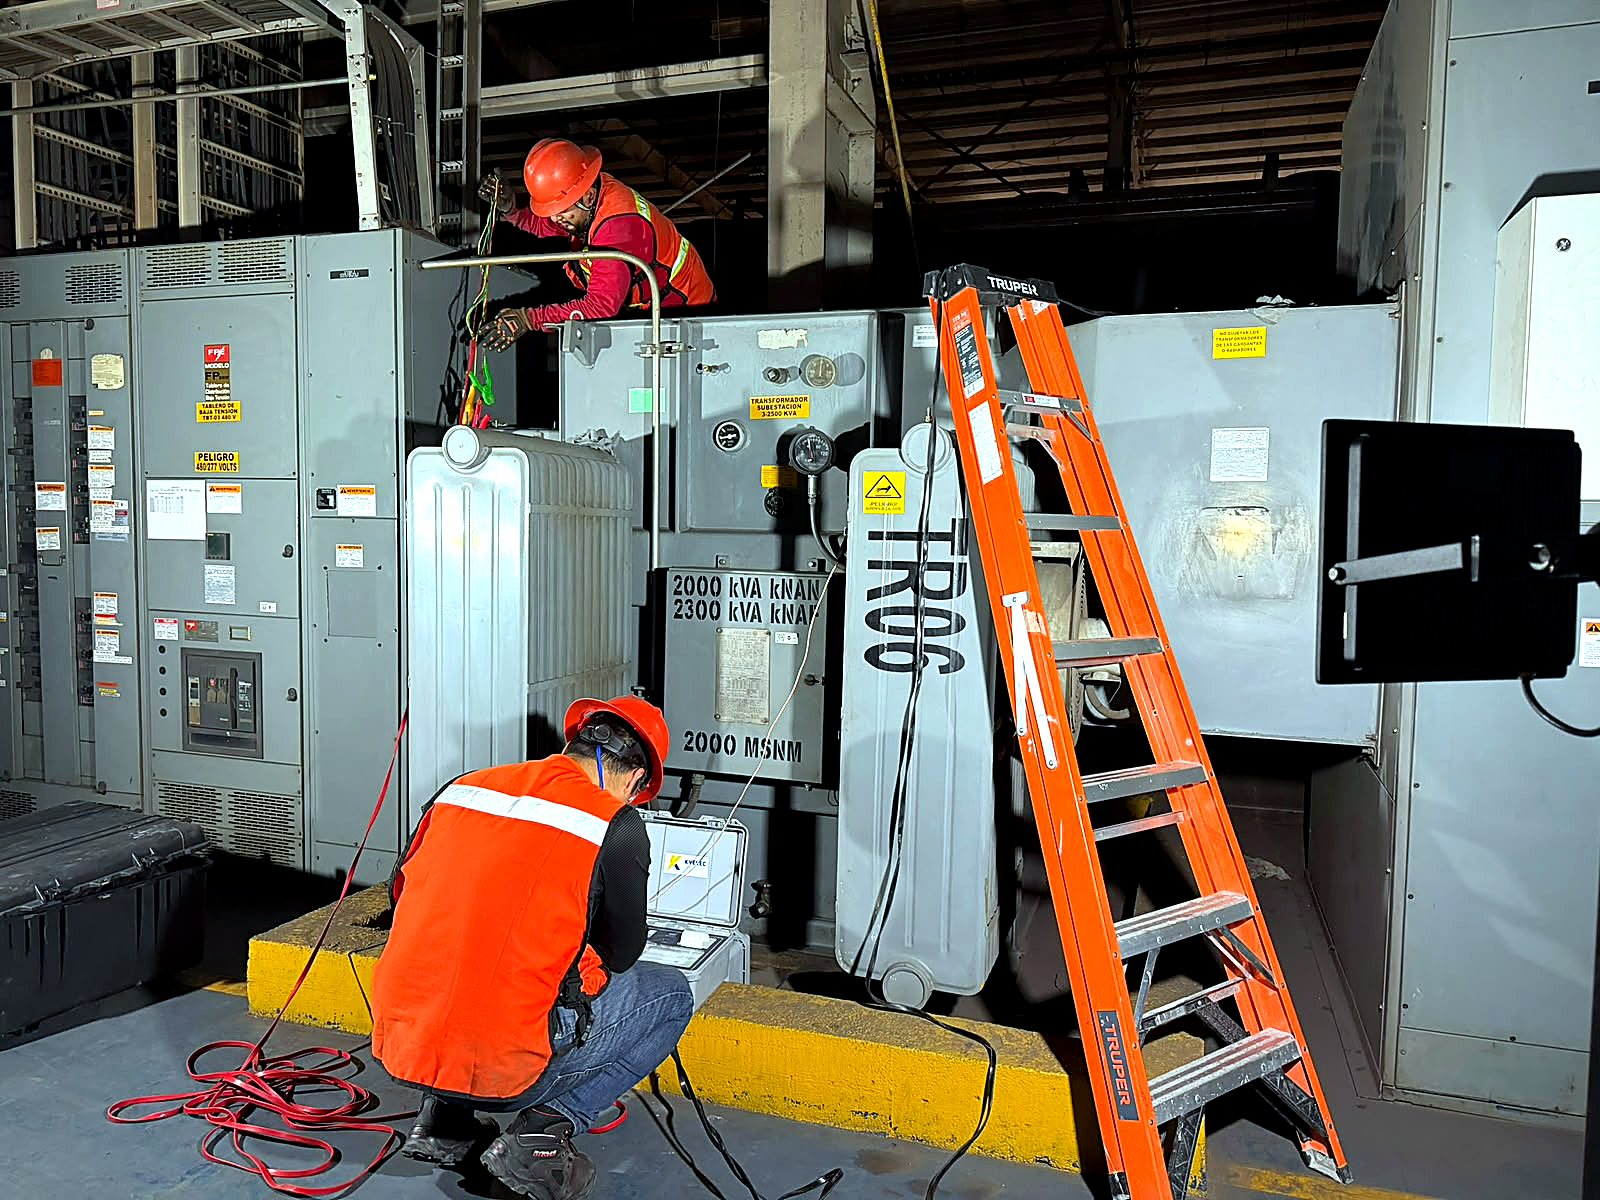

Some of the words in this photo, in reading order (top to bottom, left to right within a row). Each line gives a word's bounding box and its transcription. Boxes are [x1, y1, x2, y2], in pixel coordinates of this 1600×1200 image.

[986, 275, 1040, 297] TRUPER
[204, 371, 220, 381] FP
[750, 396, 809, 405] TRANSFORMADOR
[761, 410, 783, 418] 3-2500
[198, 452, 235, 462] PELIGRO
[218, 462, 237, 472] VOLTS
[673, 574, 722, 597] 2000
[863, 518, 969, 675] TR06
[673, 598, 721, 622] 2300
[683, 730, 737, 756] 2000
[744, 736, 802, 763] MSNM
[1105, 1023, 1131, 1105] TRUPER
